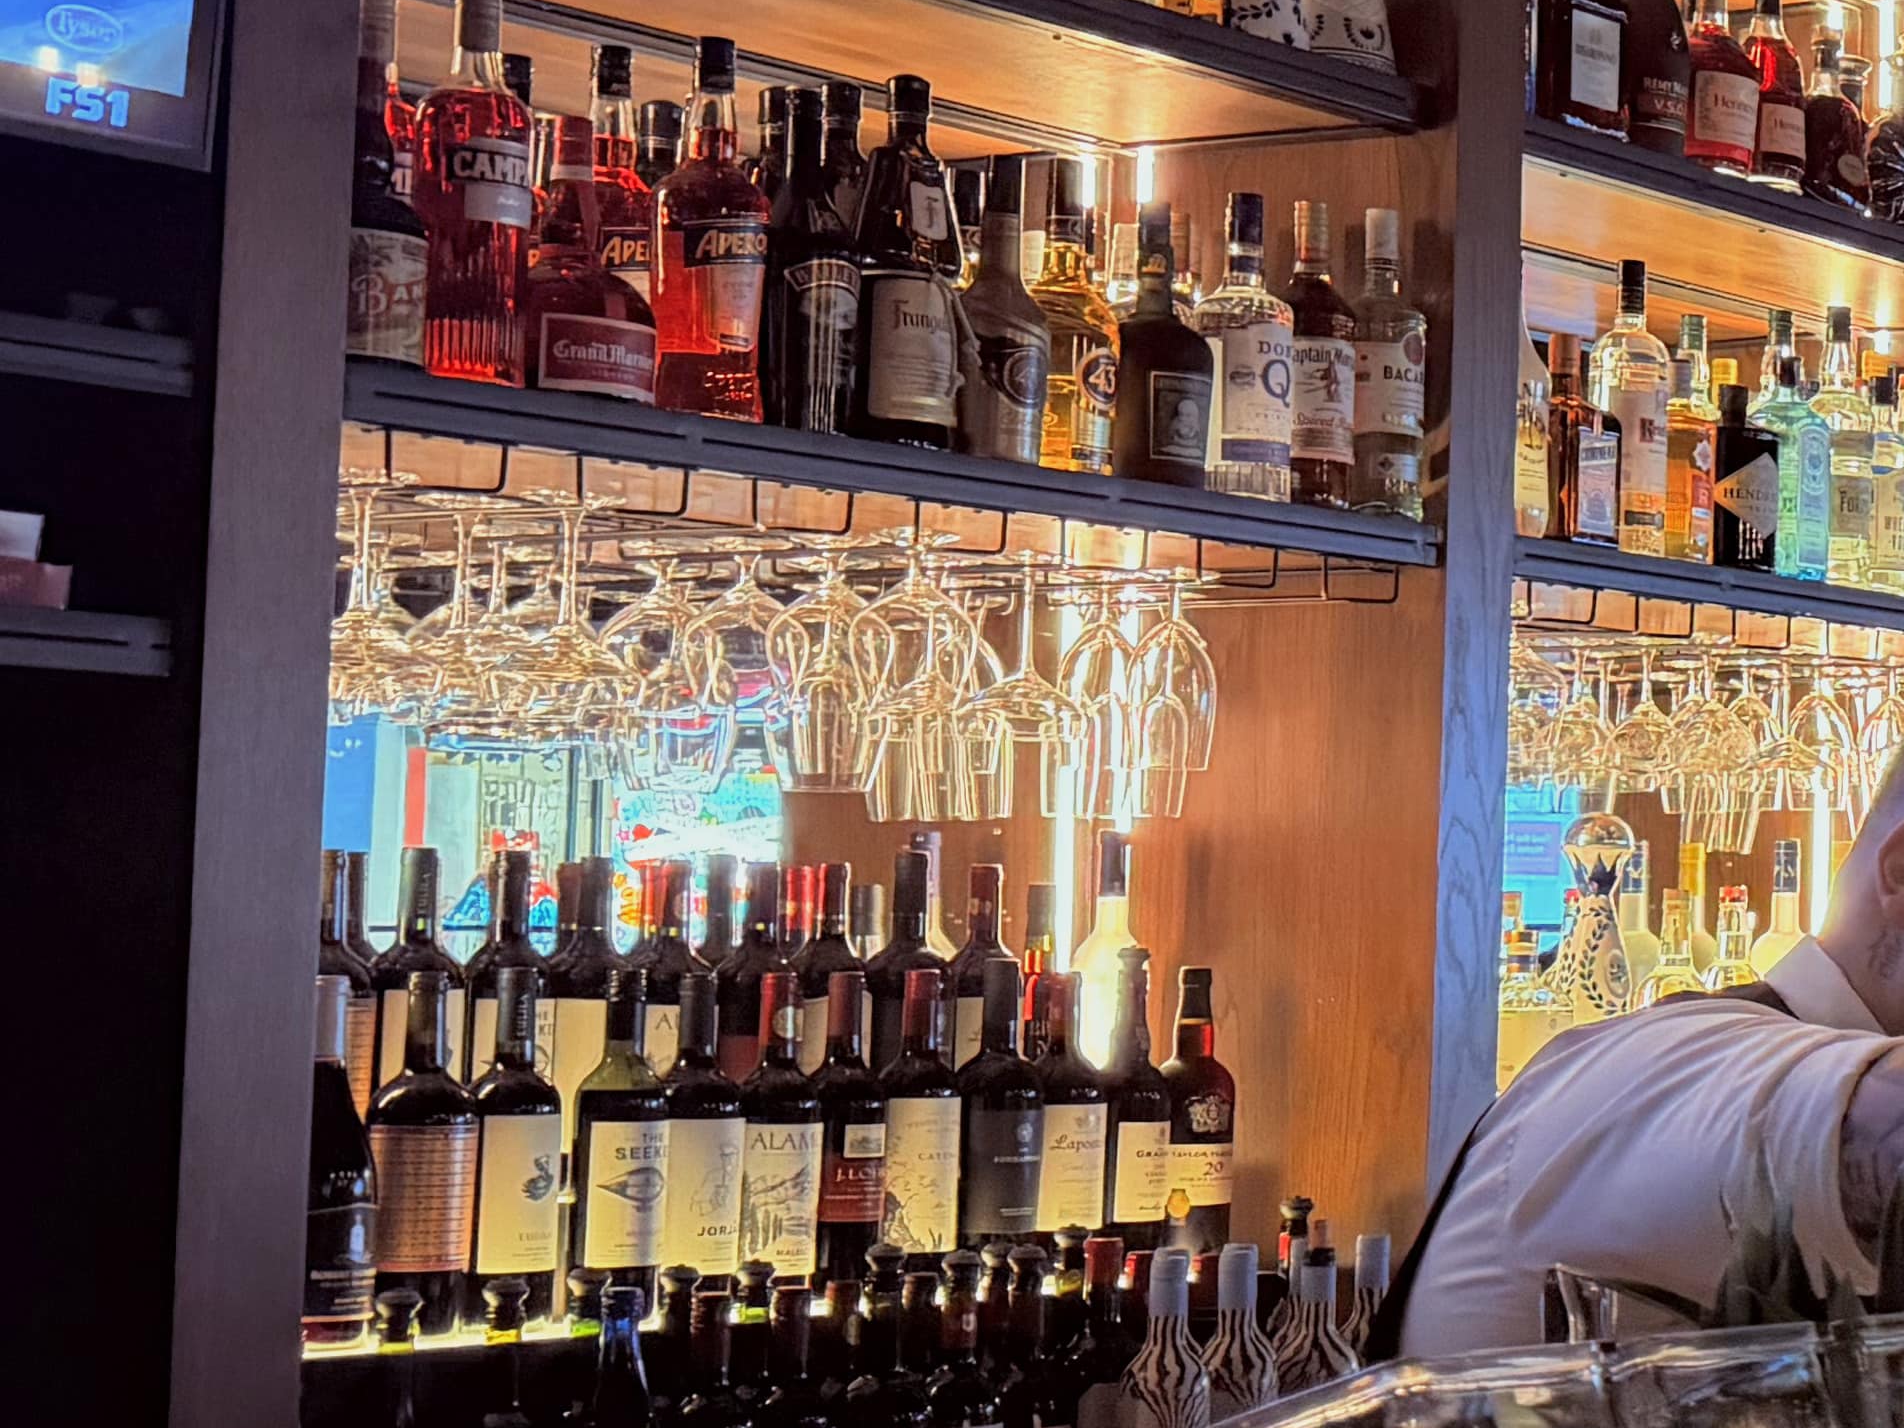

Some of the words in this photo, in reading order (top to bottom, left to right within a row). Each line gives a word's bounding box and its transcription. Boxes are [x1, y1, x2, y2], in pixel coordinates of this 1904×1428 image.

[44, 76, 130, 129] FS1
[1292, 345, 1330, 366] aptain
[1088, 364, 1117, 395] 43
[1260, 358, 1290, 409] Q
[1203, 1160, 1224, 1177] 20
